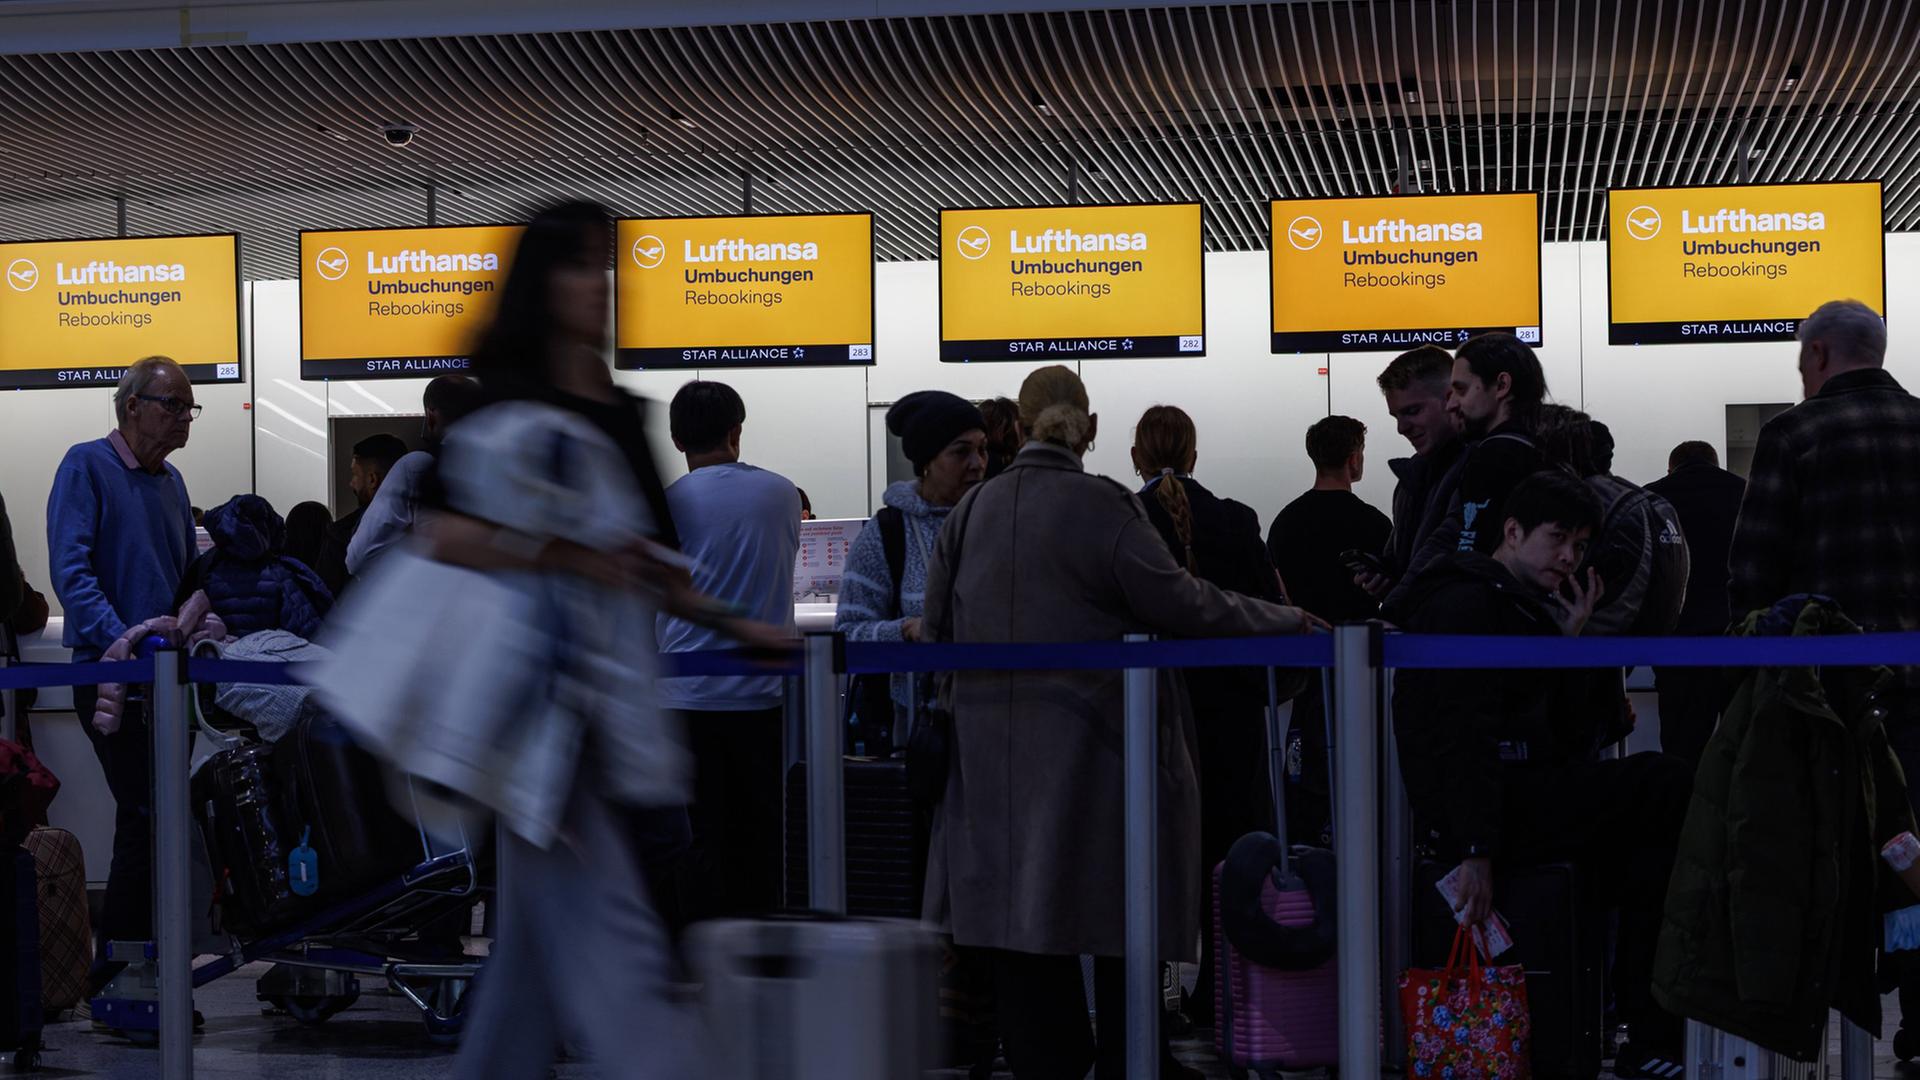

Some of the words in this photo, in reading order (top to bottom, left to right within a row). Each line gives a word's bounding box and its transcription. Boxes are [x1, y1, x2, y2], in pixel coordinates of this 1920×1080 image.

[1682, 208, 1825, 233] Lufthansa
[1342, 218, 1483, 243] Lufthansa
[1010, 228, 1147, 253] Lufthansa
[1683, 239, 1820, 257] Umbuchungen
[685, 239, 818, 262] Lufthansa
[1343, 248, 1478, 266] Umbuchungen
[368, 249, 498, 273] Lufthansa
[1011, 258, 1142, 275] Umbuchungen
[57, 261, 185, 285] Lufthansa
[685, 268, 814, 284] Umbuchungen
[1683, 262, 1788, 280] Rebookings
[369, 278, 494, 294] Umbuchungen
[1344, 271, 1446, 289] Rebookings
[59, 290, 181, 305] Umbuchungen
[1012, 281, 1111, 298] Rebookings
[686, 290, 782, 307] Rebookings
[369, 301, 464, 317] Rebookings
[60, 311, 152, 328] Rebookings
[1520, 330, 1535, 340] 281
[1681, 324, 1718, 335] STAR
[1723, 322, 1795, 334] ALLIANCE
[1182, 340, 1199, 348] 282
[1341, 333, 1377, 344] STAR
[1382, 332, 1453, 343] ALLIANCE
[682, 350, 717, 360] STAR
[722, 348, 788, 360] ALLIANCE
[852, 348, 869, 357] 283
[1010, 342, 1044, 353] STAR
[1048, 340, 1116, 352] ALLIANCE
[220, 367, 236, 375] 285
[367, 360, 400, 371] STAR
[404, 358, 470, 370] ALLIANCE
[58, 370, 91, 381] STAR
[95, 369, 129, 380] ALLIA
